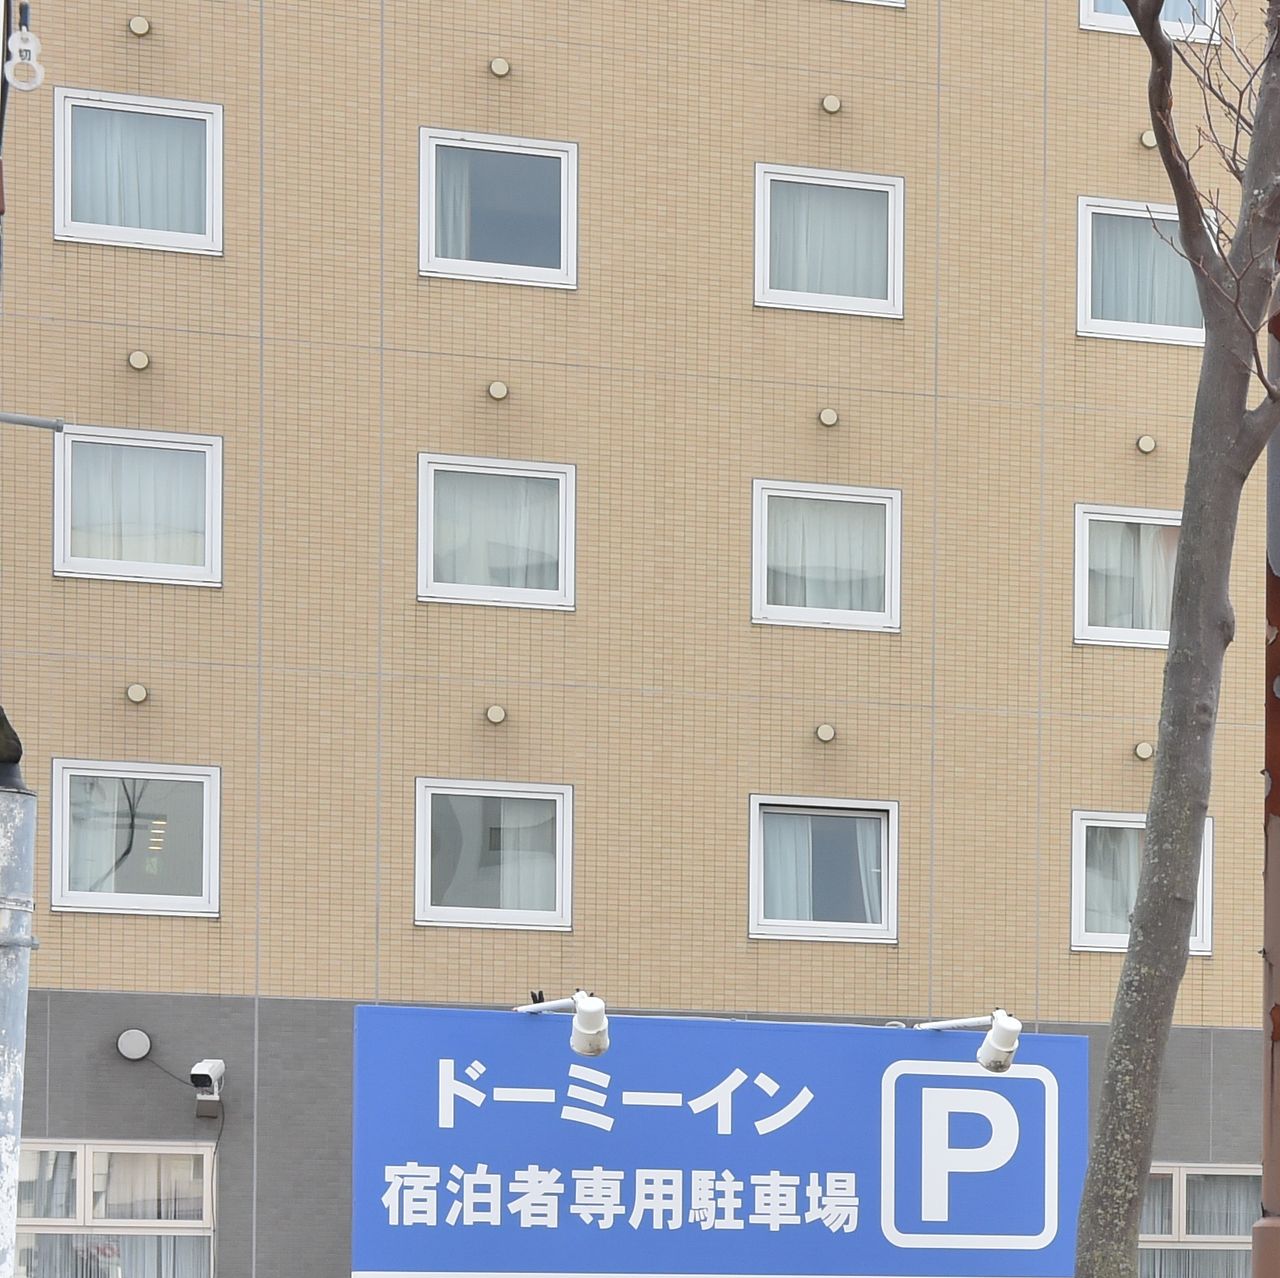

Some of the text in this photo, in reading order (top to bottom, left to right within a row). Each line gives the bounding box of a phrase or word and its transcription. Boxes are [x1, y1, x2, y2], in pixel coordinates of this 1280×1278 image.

[438, 1058, 815, 1136] ドーミーイン
[921, 1087, 1020, 1223] P
[381, 1162, 860, 1233] 宿泊者専用駐車場
